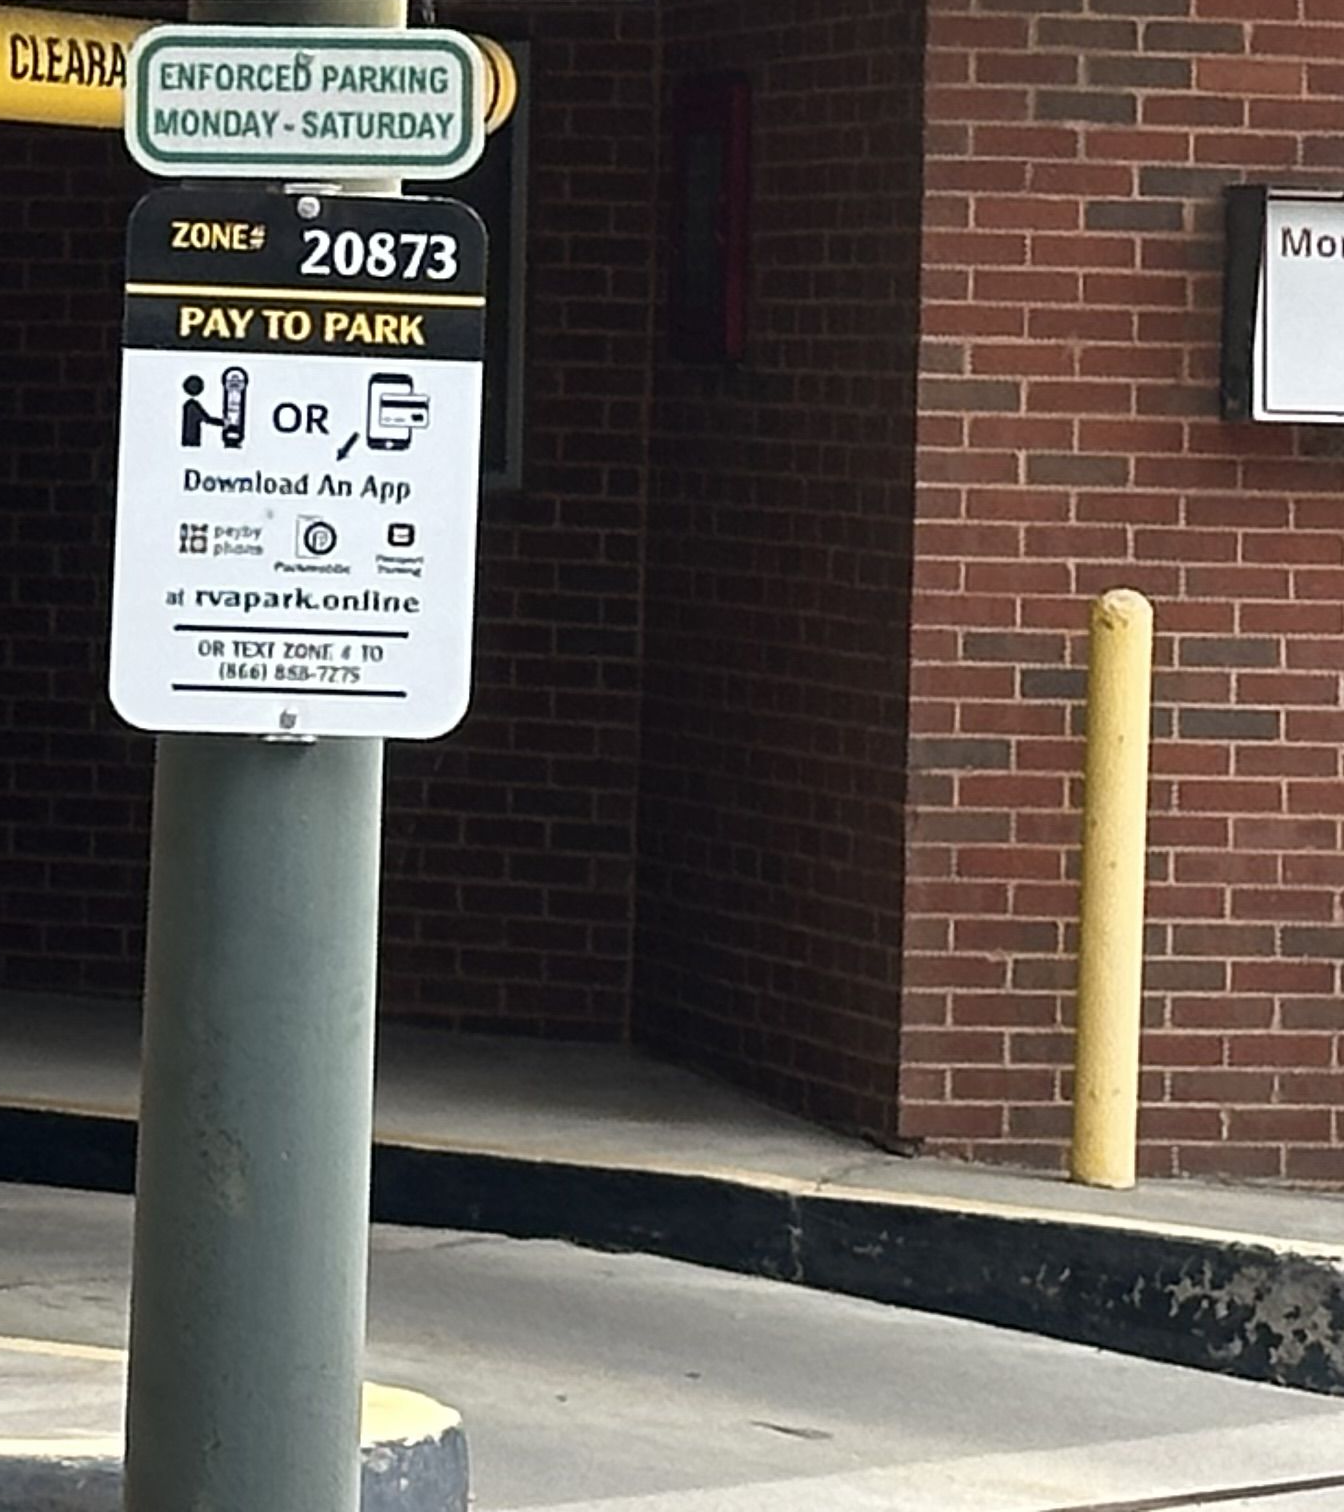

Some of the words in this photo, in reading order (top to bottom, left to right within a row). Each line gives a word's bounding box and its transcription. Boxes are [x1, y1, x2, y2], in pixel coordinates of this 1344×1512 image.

[10, 33, 127, 89] CLEARA
[160, 62, 310, 93] ENFORCED
[323, 63, 448, 95] PARKING
[300, 230, 458, 280] 20873
[180, 307, 254, 338] PAY
[262, 309, 312, 340] TO
[325, 312, 426, 346] PARK
[273, 402, 330, 435] OR
[183, 469, 308, 497] Download
[317, 474, 353, 497] An
[361, 474, 412, 504] App
[165, 589, 185, 606] at
[194, 587, 421, 614] rvapark.online
[197, 640, 225, 657] OR
[232, 641, 276, 660] TEXT
[283, 642, 333, 661] ZONE
[362, 644, 384, 662] TO
